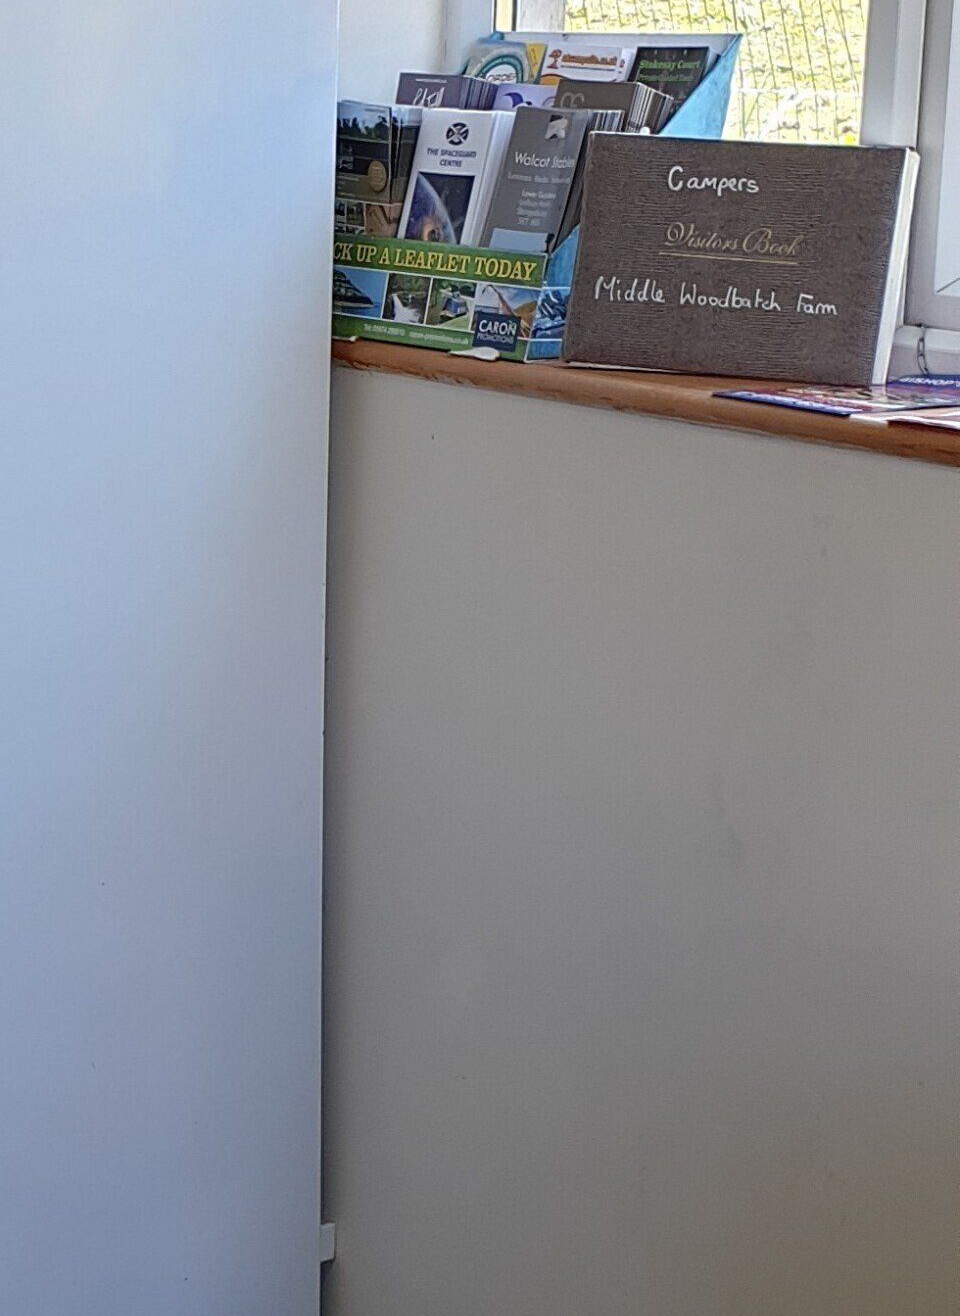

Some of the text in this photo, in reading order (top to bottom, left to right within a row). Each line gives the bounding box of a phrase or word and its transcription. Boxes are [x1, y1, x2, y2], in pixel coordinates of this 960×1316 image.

[639, 59, 701, 72] Stokesay Court
[426, 147, 439, 156] THE
[514, 151, 550, 168] Walcot
[439, 158, 462, 168] CENTRE
[667, 165, 760, 197] Campers
[664, 221, 804, 257] Visitors Book
[356, 244, 378, 263] UP
[378, 247, 391, 265] A
[393, 248, 471, 274] LEAFLET
[474, 256, 537, 282] TODAY
[594, 275, 838, 316] Middle Woodbatch Farm
[478, 319, 517, 336] CARON
